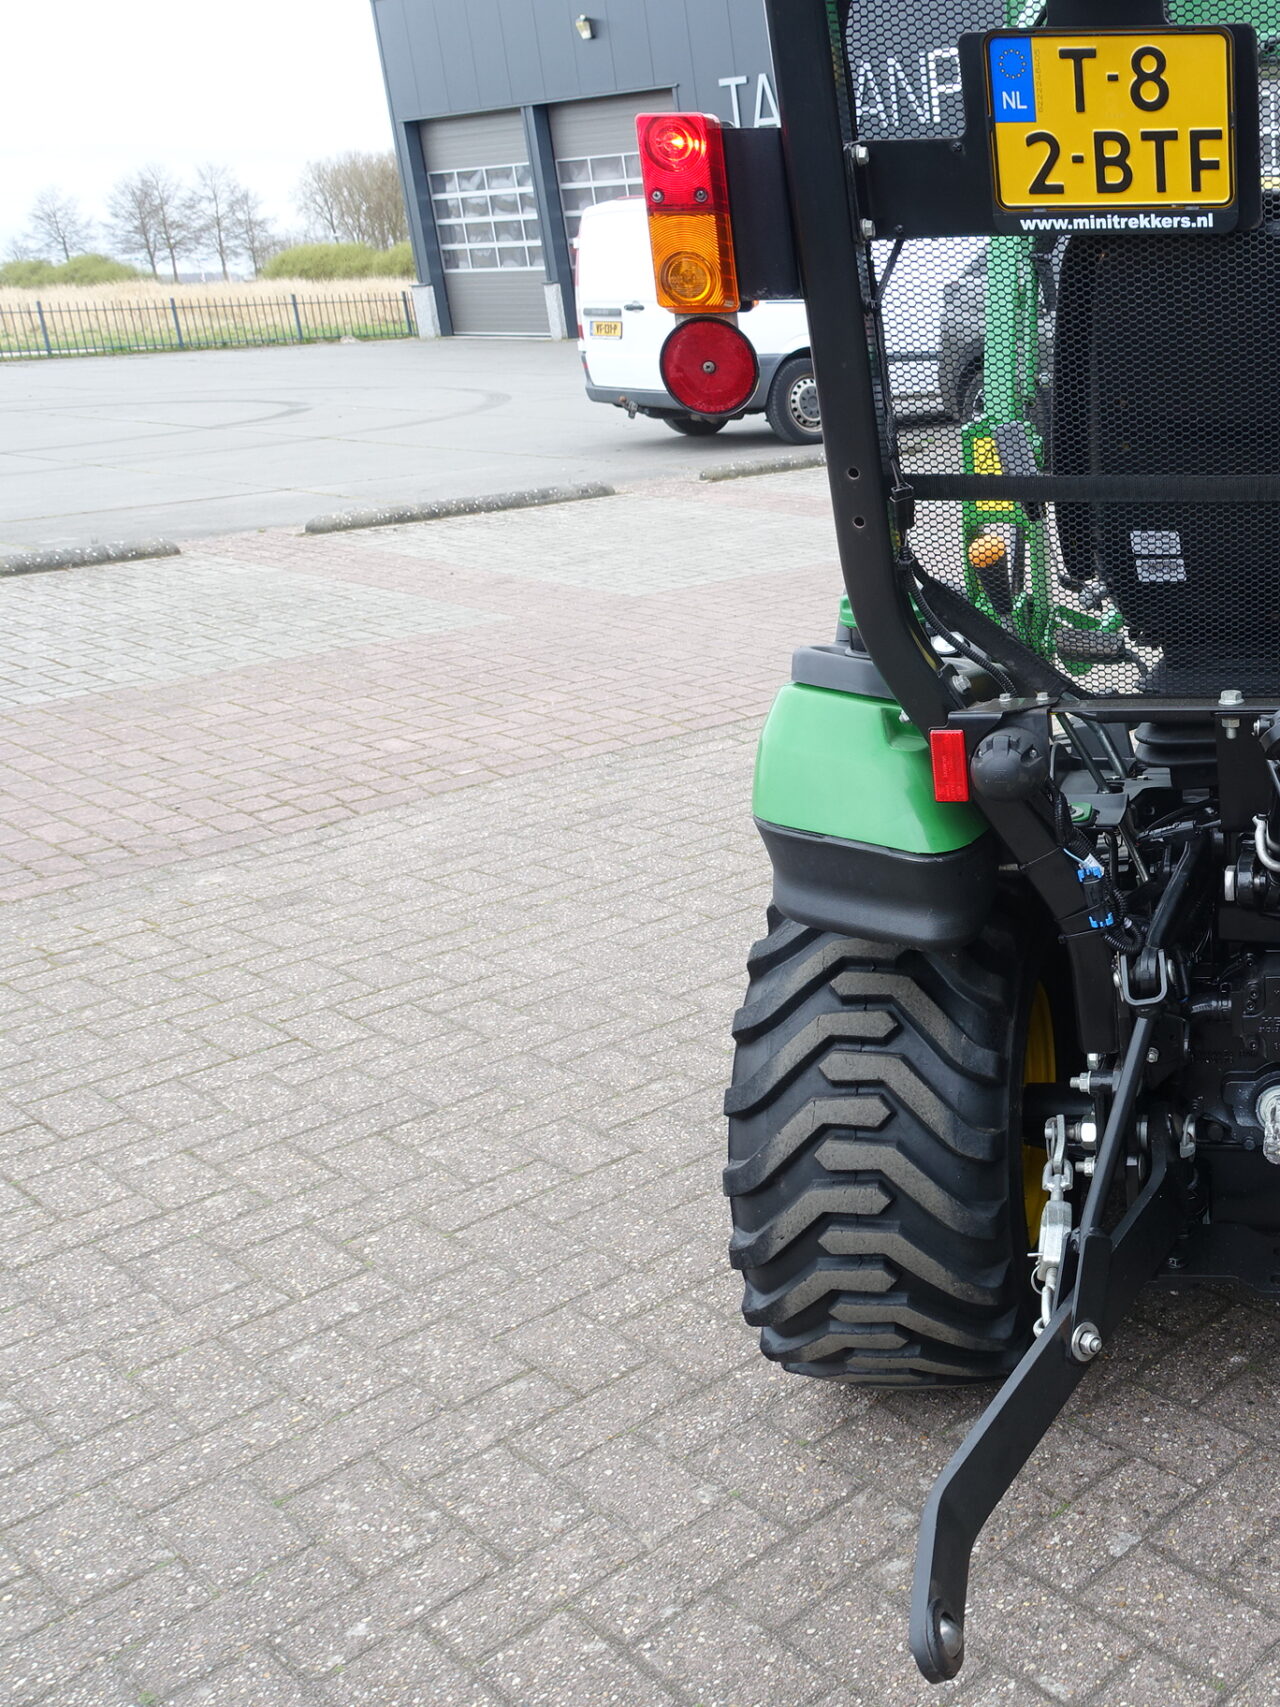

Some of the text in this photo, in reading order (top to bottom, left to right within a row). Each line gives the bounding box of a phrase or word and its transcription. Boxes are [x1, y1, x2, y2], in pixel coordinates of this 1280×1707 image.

[1002, 91, 1028, 110] NL
[1058, 45, 1170, 113] T-8
[1025, 128, 1223, 195] 2-BTF
[1020, 213, 1214, 231] www.minitrekkers.nl
